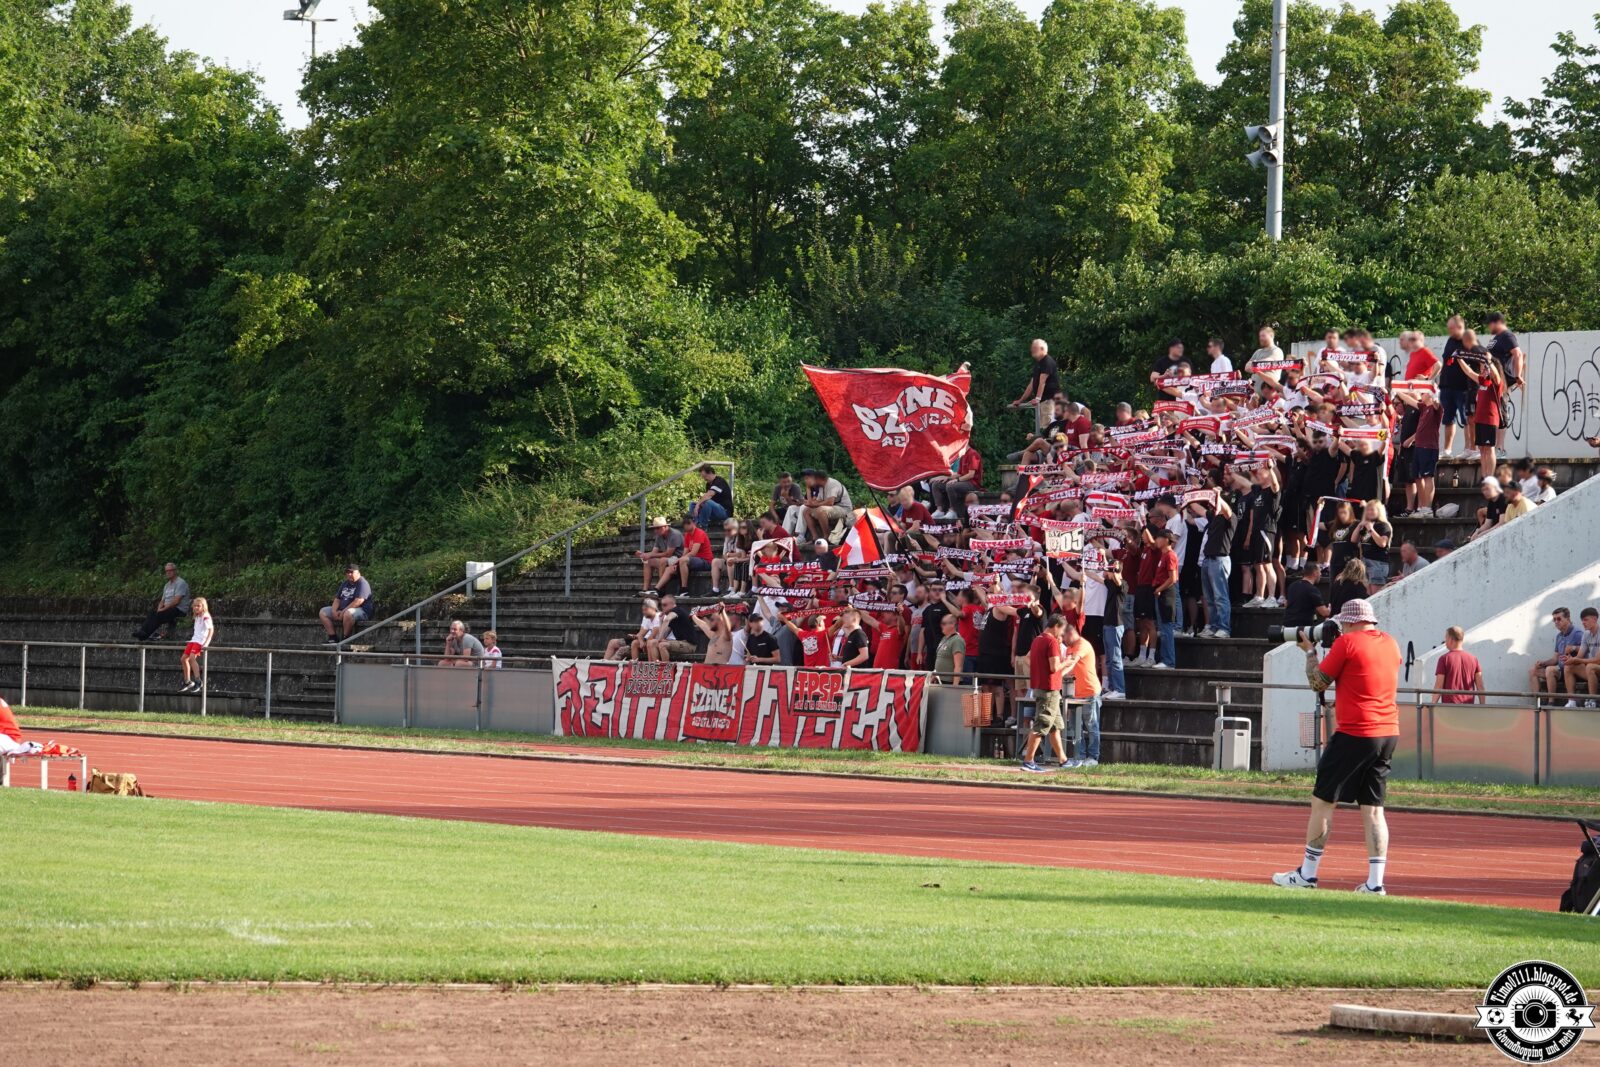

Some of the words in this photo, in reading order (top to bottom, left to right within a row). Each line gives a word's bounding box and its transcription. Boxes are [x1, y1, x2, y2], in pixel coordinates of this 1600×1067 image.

[765, 563, 792, 572] SEIT
[691, 682, 730, 714] SZENE
[726, 683, 739, 719] E
[797, 671, 843, 702] TPSP
